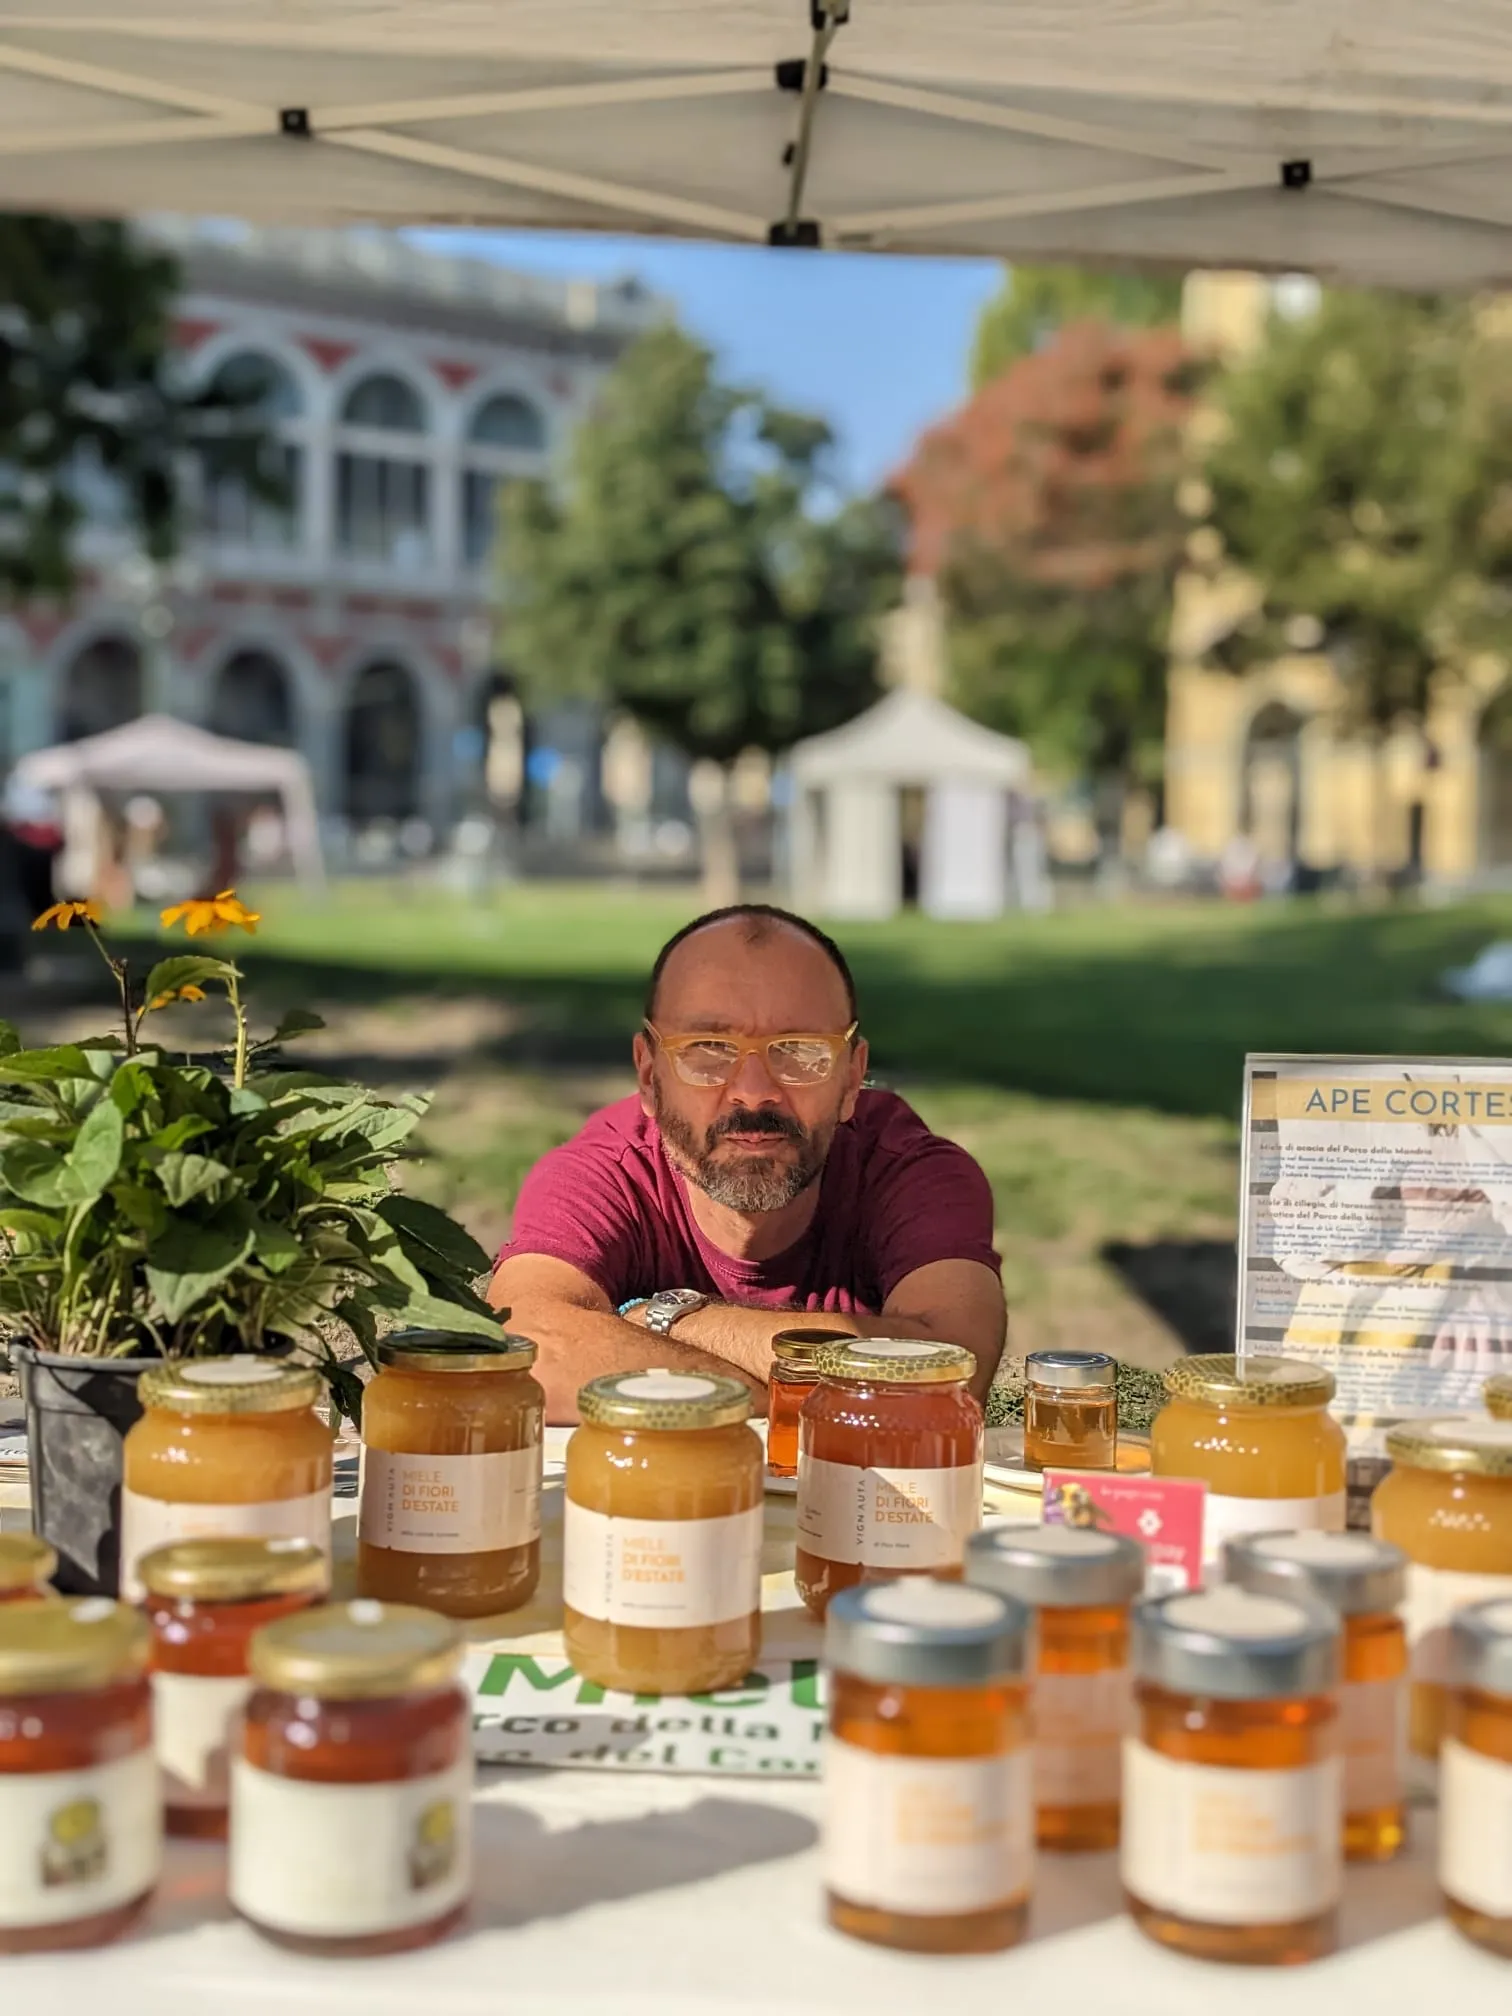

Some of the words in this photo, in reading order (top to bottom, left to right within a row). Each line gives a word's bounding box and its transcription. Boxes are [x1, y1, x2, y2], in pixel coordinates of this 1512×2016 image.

[1306, 1087, 1371, 1114] APE
[1385, 1090, 1512, 1117] CORTE
[1285, 1143, 1293, 1152] di
[1296, 1144, 1325, 1153] acacia
[1327, 1144, 1341, 1154] del
[1343, 1144, 1368, 1155] Parco
[1370, 1145, 1392, 1155] della
[1284, 1198, 1292, 1207] di
[1330, 1200, 1339, 1209] di
[1297, 1211, 1310, 1220] del
[1313, 1212, 1338, 1221] Parco
[1340, 1212, 1362, 1221] della
[402, 1470, 442, 1482] MIELE
[402, 1484, 415, 1496] DI
[419, 1485, 454, 1497] FIORI
[876, 1481, 917, 1494] MIELE
[402, 1499, 460, 1513] D'ESTATE
[876, 1495, 889, 1508] DI
[894, 1496, 928, 1509] FIORI
[875, 1510, 934, 1524] D'ESTATE
[473, 1713, 579, 1734] rco
[611, 1714, 780, 1741] della
